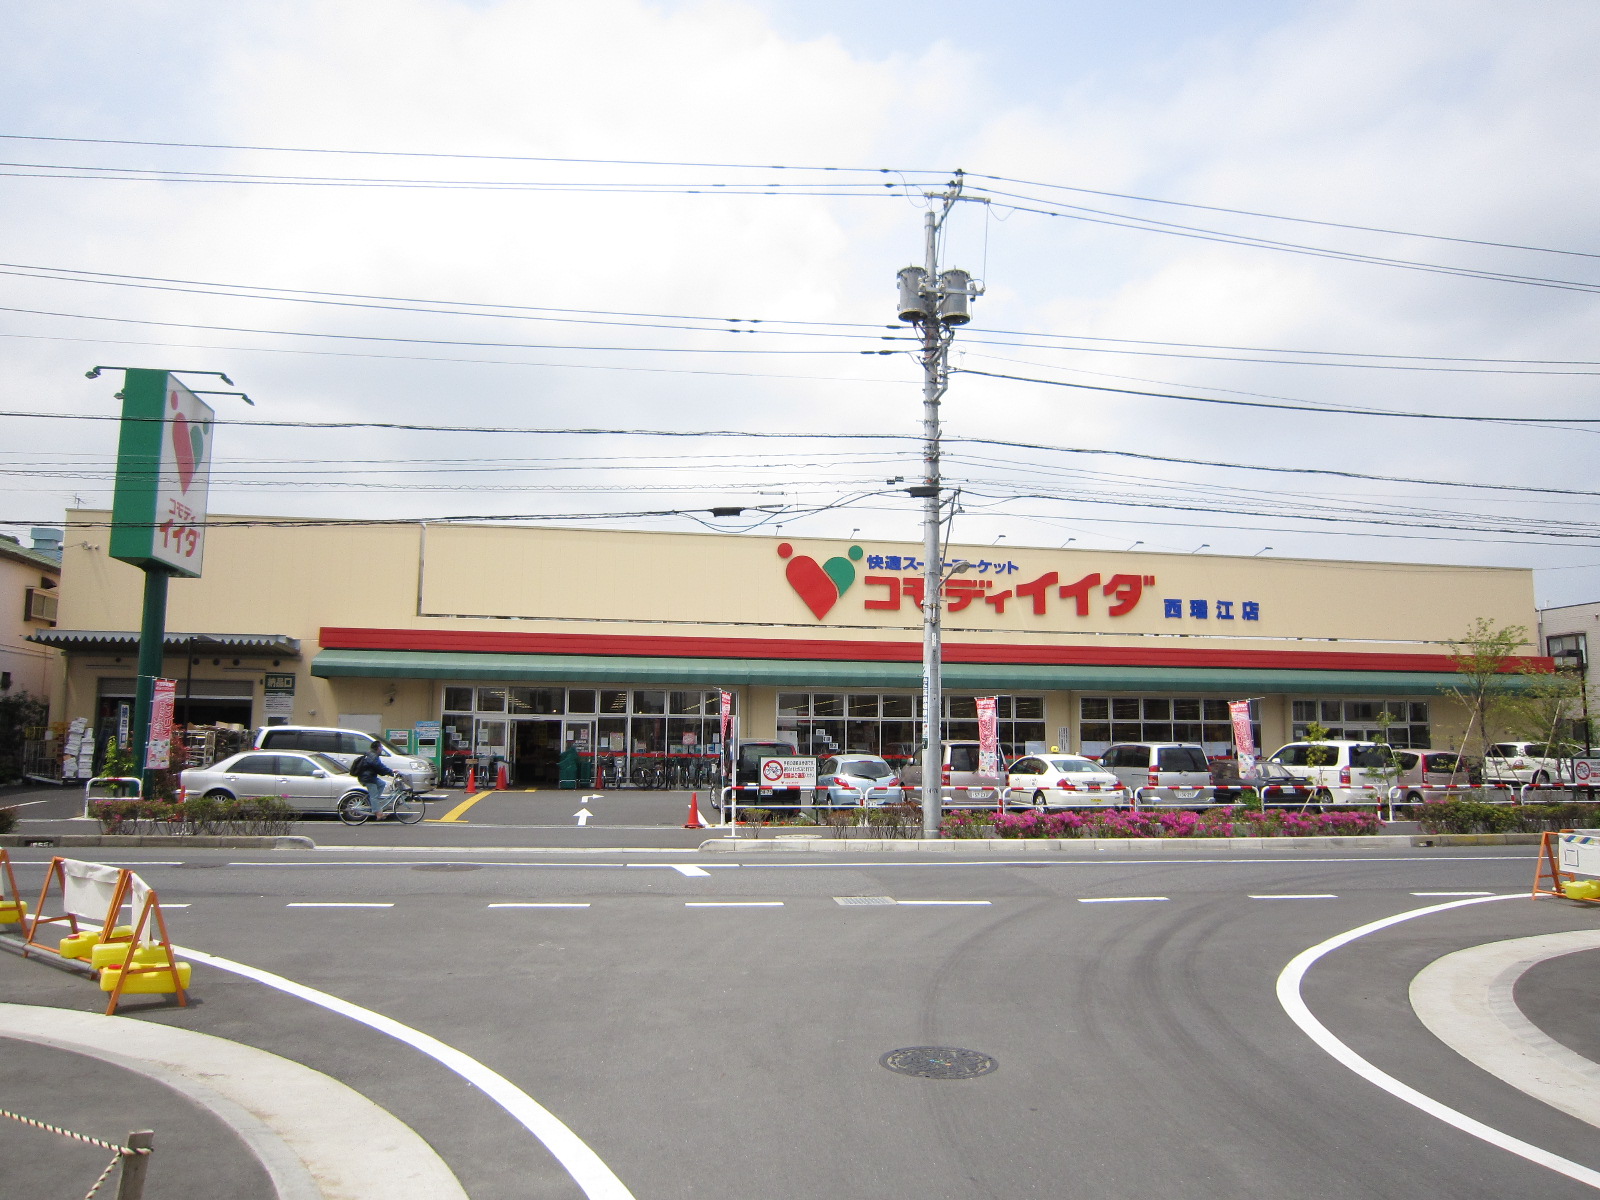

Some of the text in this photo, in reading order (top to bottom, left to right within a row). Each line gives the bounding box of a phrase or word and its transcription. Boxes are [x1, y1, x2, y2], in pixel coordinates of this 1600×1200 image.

[168, 497, 196, 522] コモディ
[159, 518, 200, 558] イイダ
[866, 554, 1020, 574] 快適スーーーケット
[864, 571, 1156, 617] コモディイイダ
[1163, 598, 1260, 621] 西瑞江店
